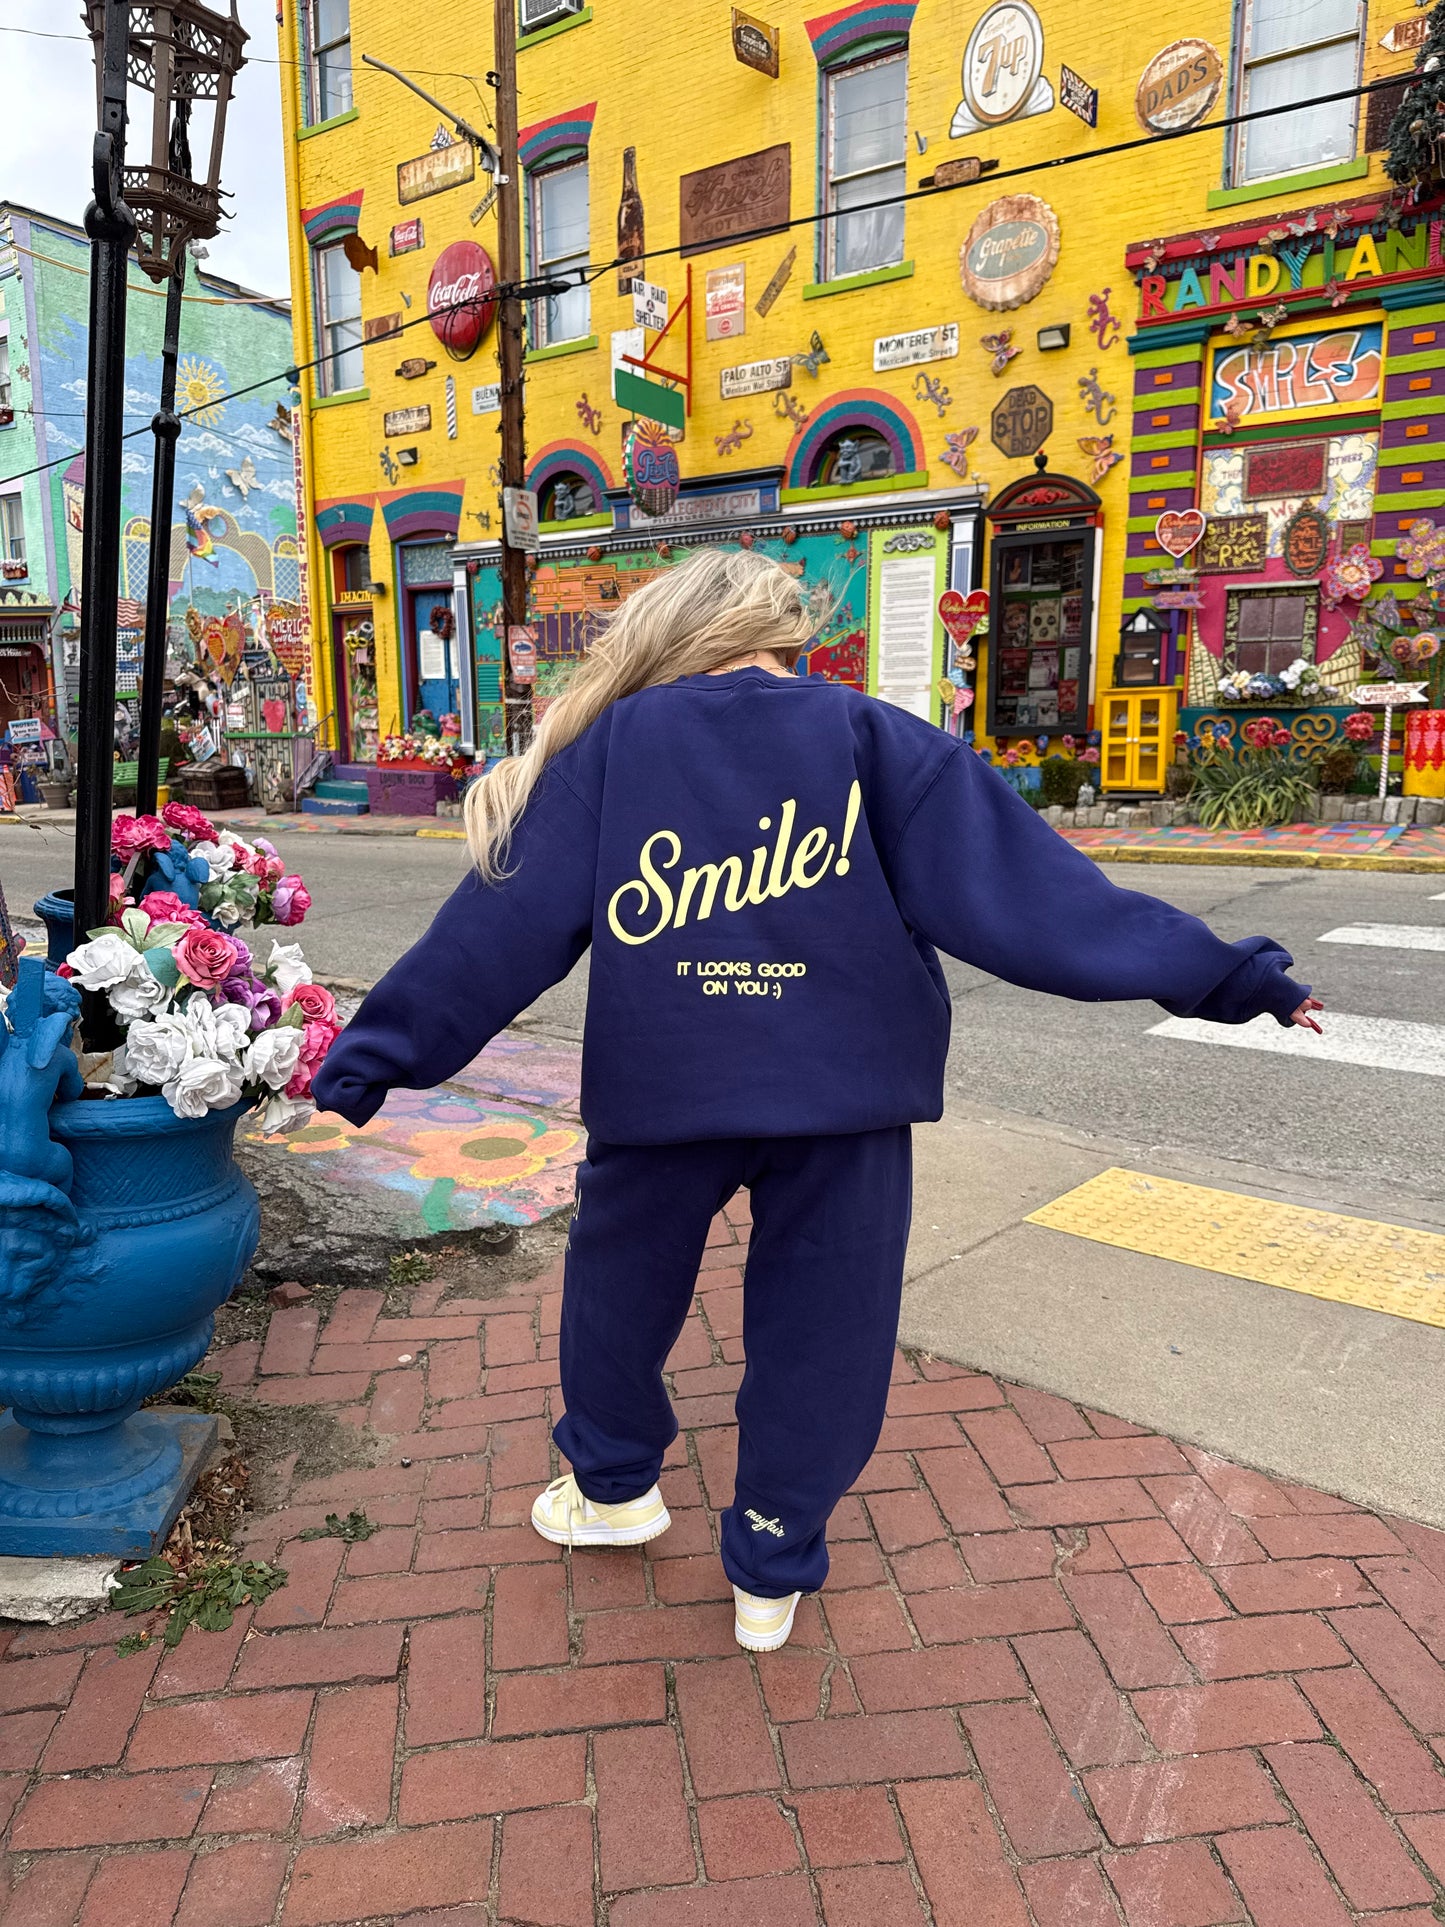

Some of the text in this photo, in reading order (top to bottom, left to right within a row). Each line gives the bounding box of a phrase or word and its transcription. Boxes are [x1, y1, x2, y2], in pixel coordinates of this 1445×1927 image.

[1145, 56, 1208, 115] DAD'S
[975, 226, 1039, 272] Grapette
[633, 280, 667, 305] AIR RAID
[635, 308, 666, 332] SHELTER
[723, 366, 747, 384] PALO
[749, 364, 772, 379] ALTO
[995, 405, 1048, 439] STOP
[1328, 452, 1364, 467] OTHERS
[729, 492, 758, 510] CITY
[1016, 518, 1071, 532] INFORMATION
[11, 720, 39, 730] PROTECT
[607, 778, 862, 946] Smile!
[676, 961, 807, 978] IT LOOKS GOOD
[702, 980, 728, 995] ON
[734, 980, 769, 996] YOU
[744, 1508, 786, 1538] mayfair
